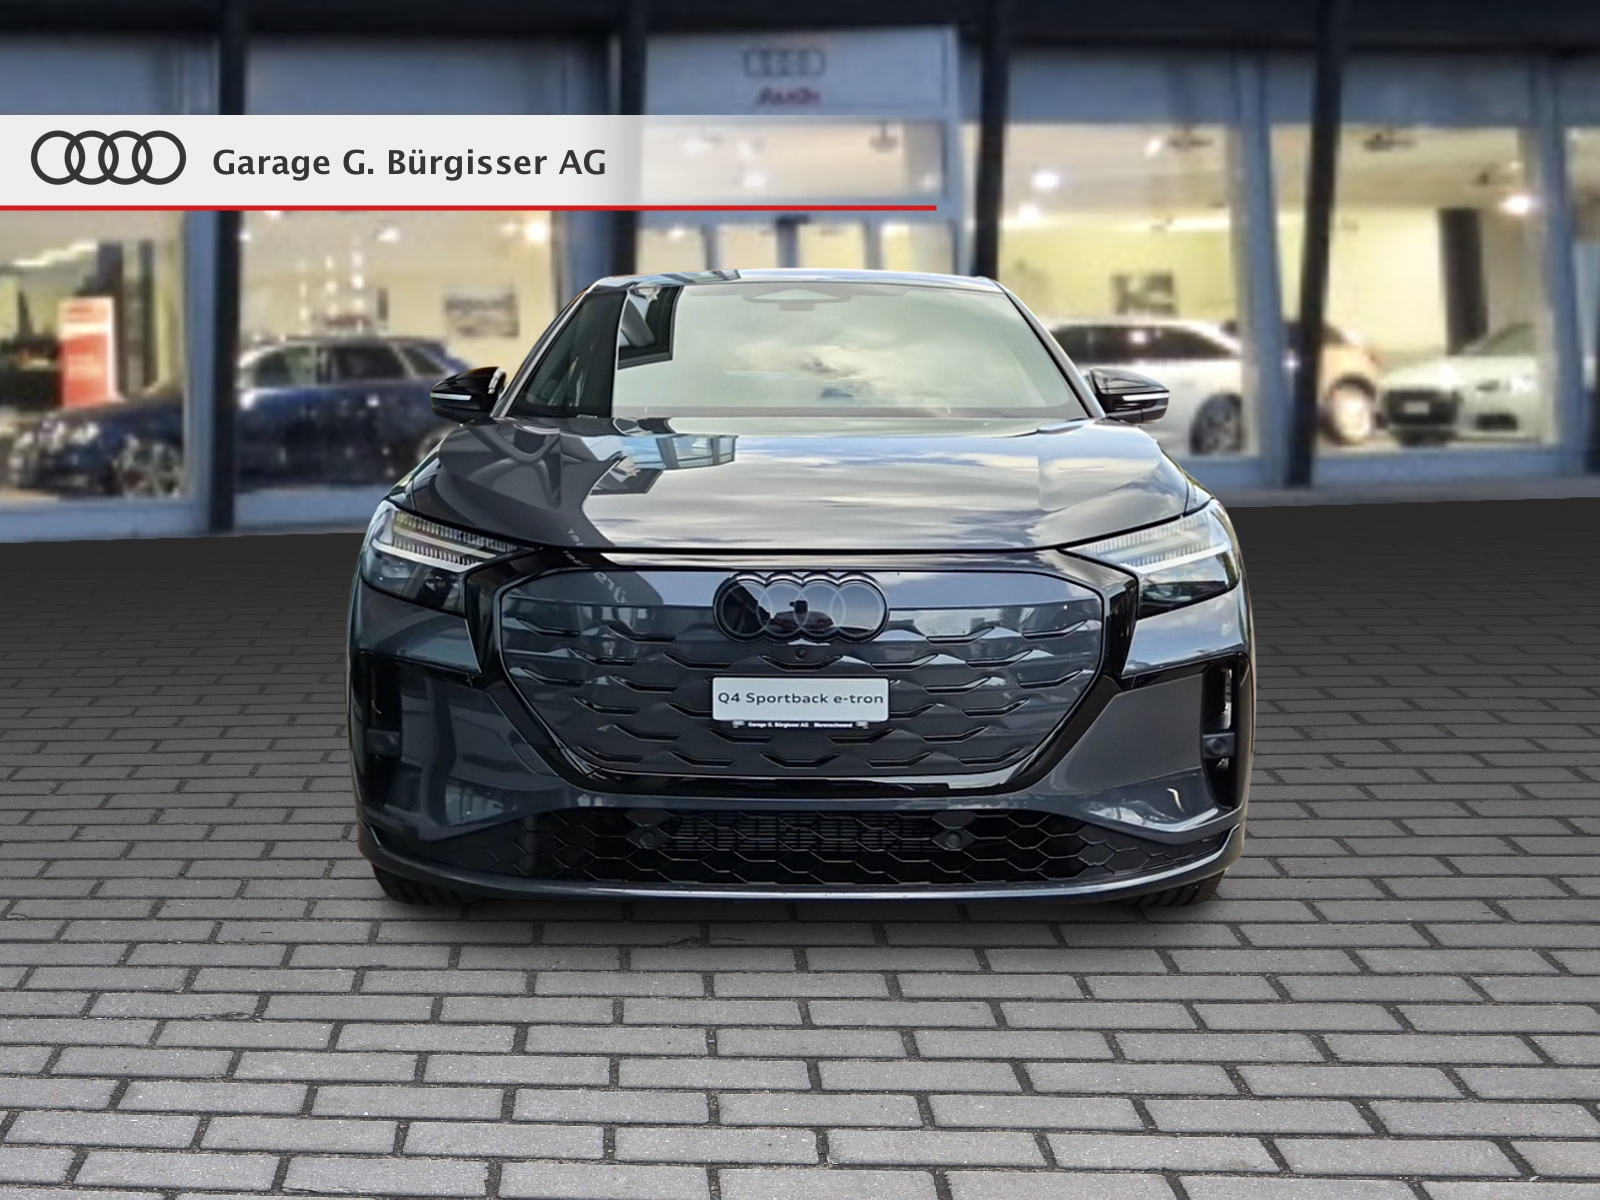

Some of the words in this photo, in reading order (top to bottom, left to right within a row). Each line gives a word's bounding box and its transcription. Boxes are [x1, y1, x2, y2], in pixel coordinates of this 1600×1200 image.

[718, 692, 741, 705] Q4
[746, 692, 829, 706] Sportback
[833, 694, 884, 704] e-tron
